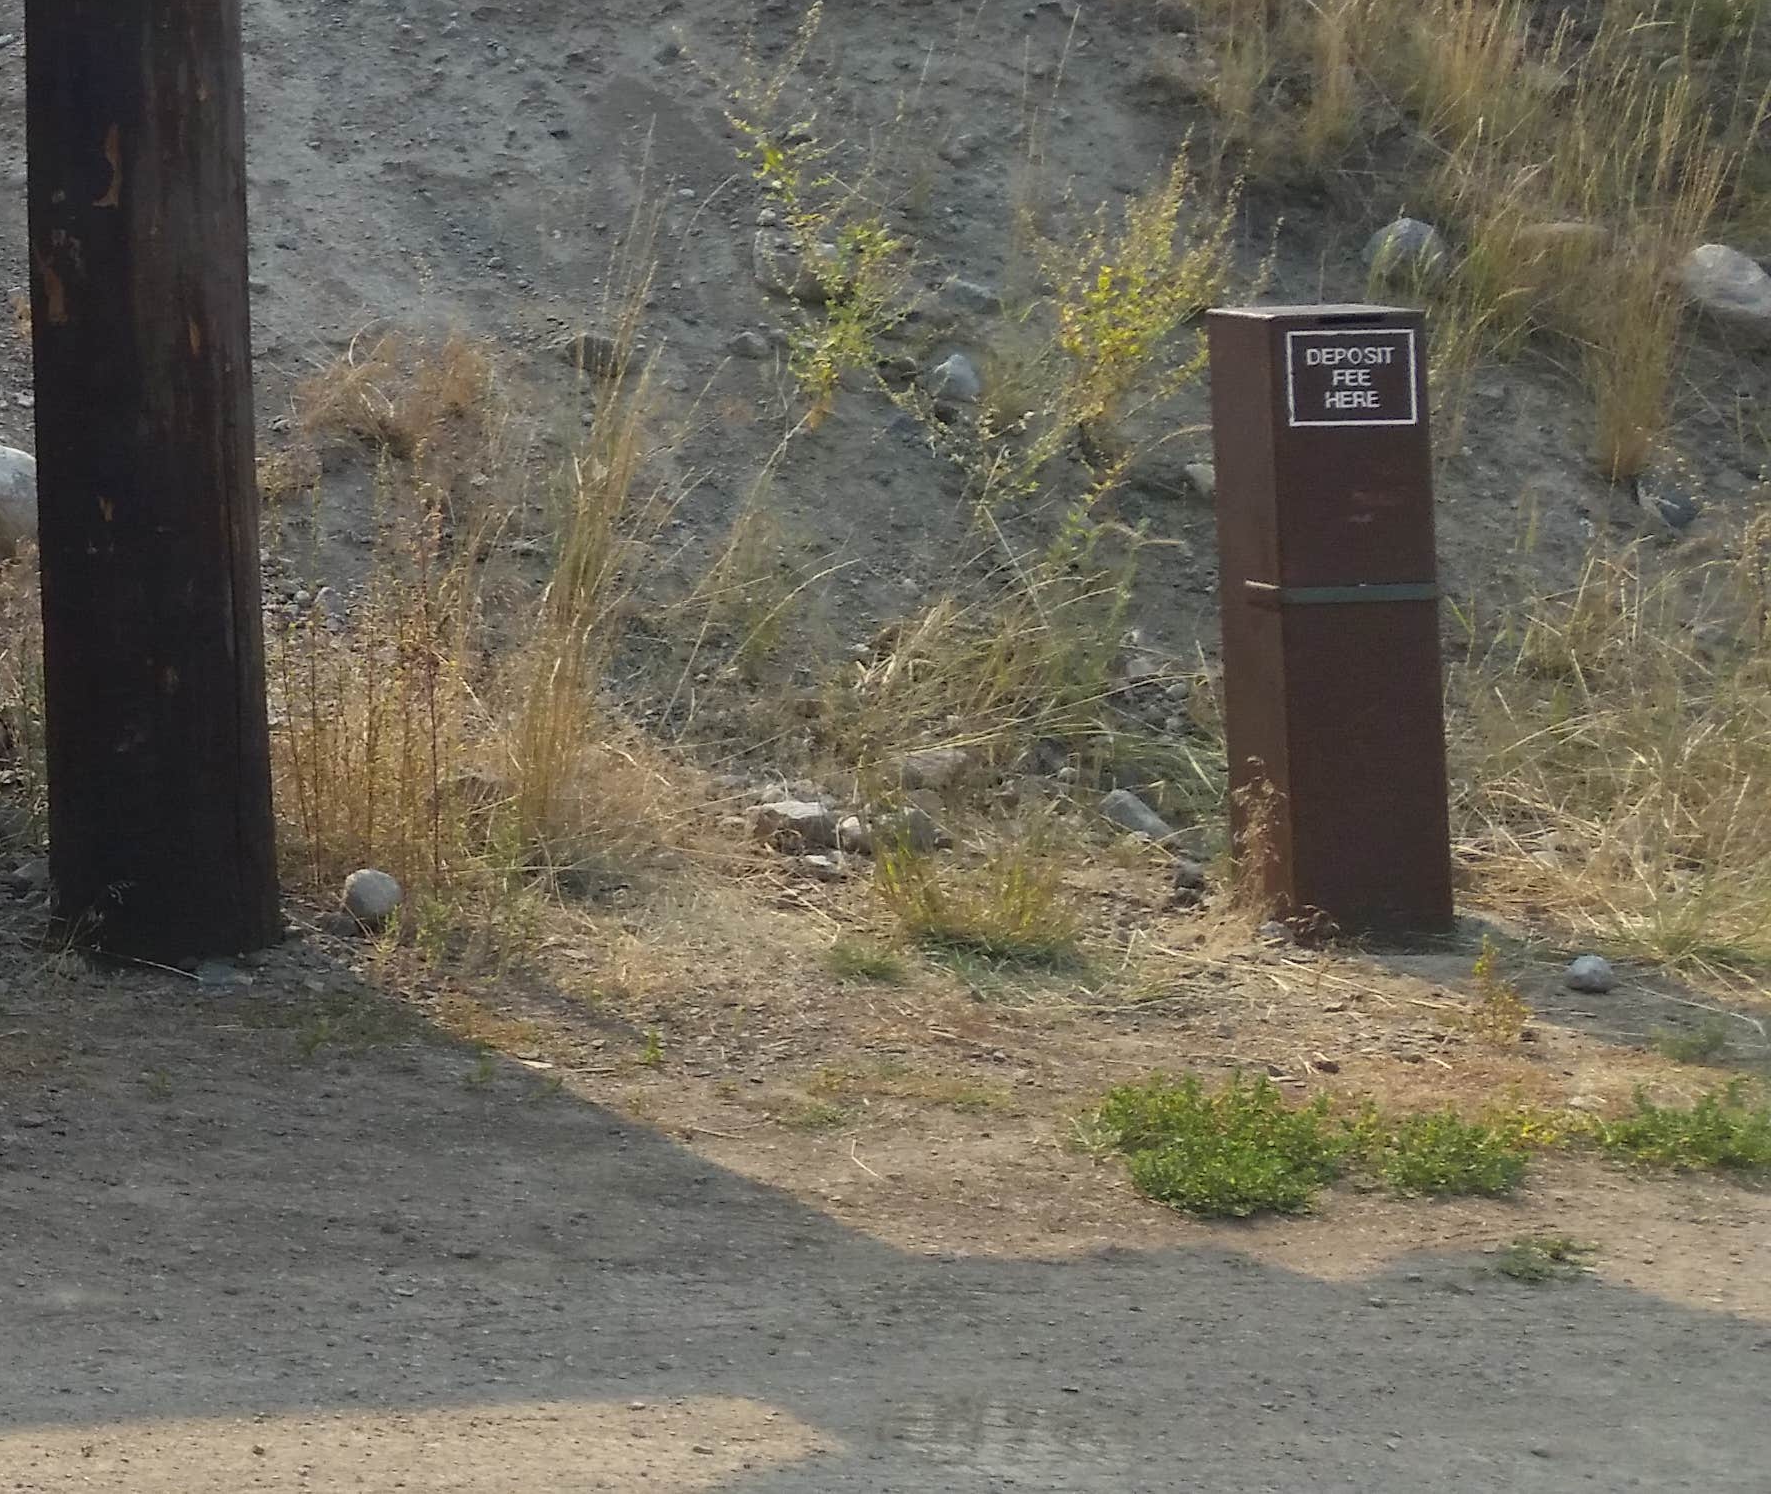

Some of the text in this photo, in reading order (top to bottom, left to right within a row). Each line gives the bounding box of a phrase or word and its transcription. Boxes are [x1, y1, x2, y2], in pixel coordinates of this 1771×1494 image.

[1305, 346, 1396, 366] DEPOSIT
[1331, 368, 1372, 387] FEE
[1324, 390, 1381, 409] HERE
